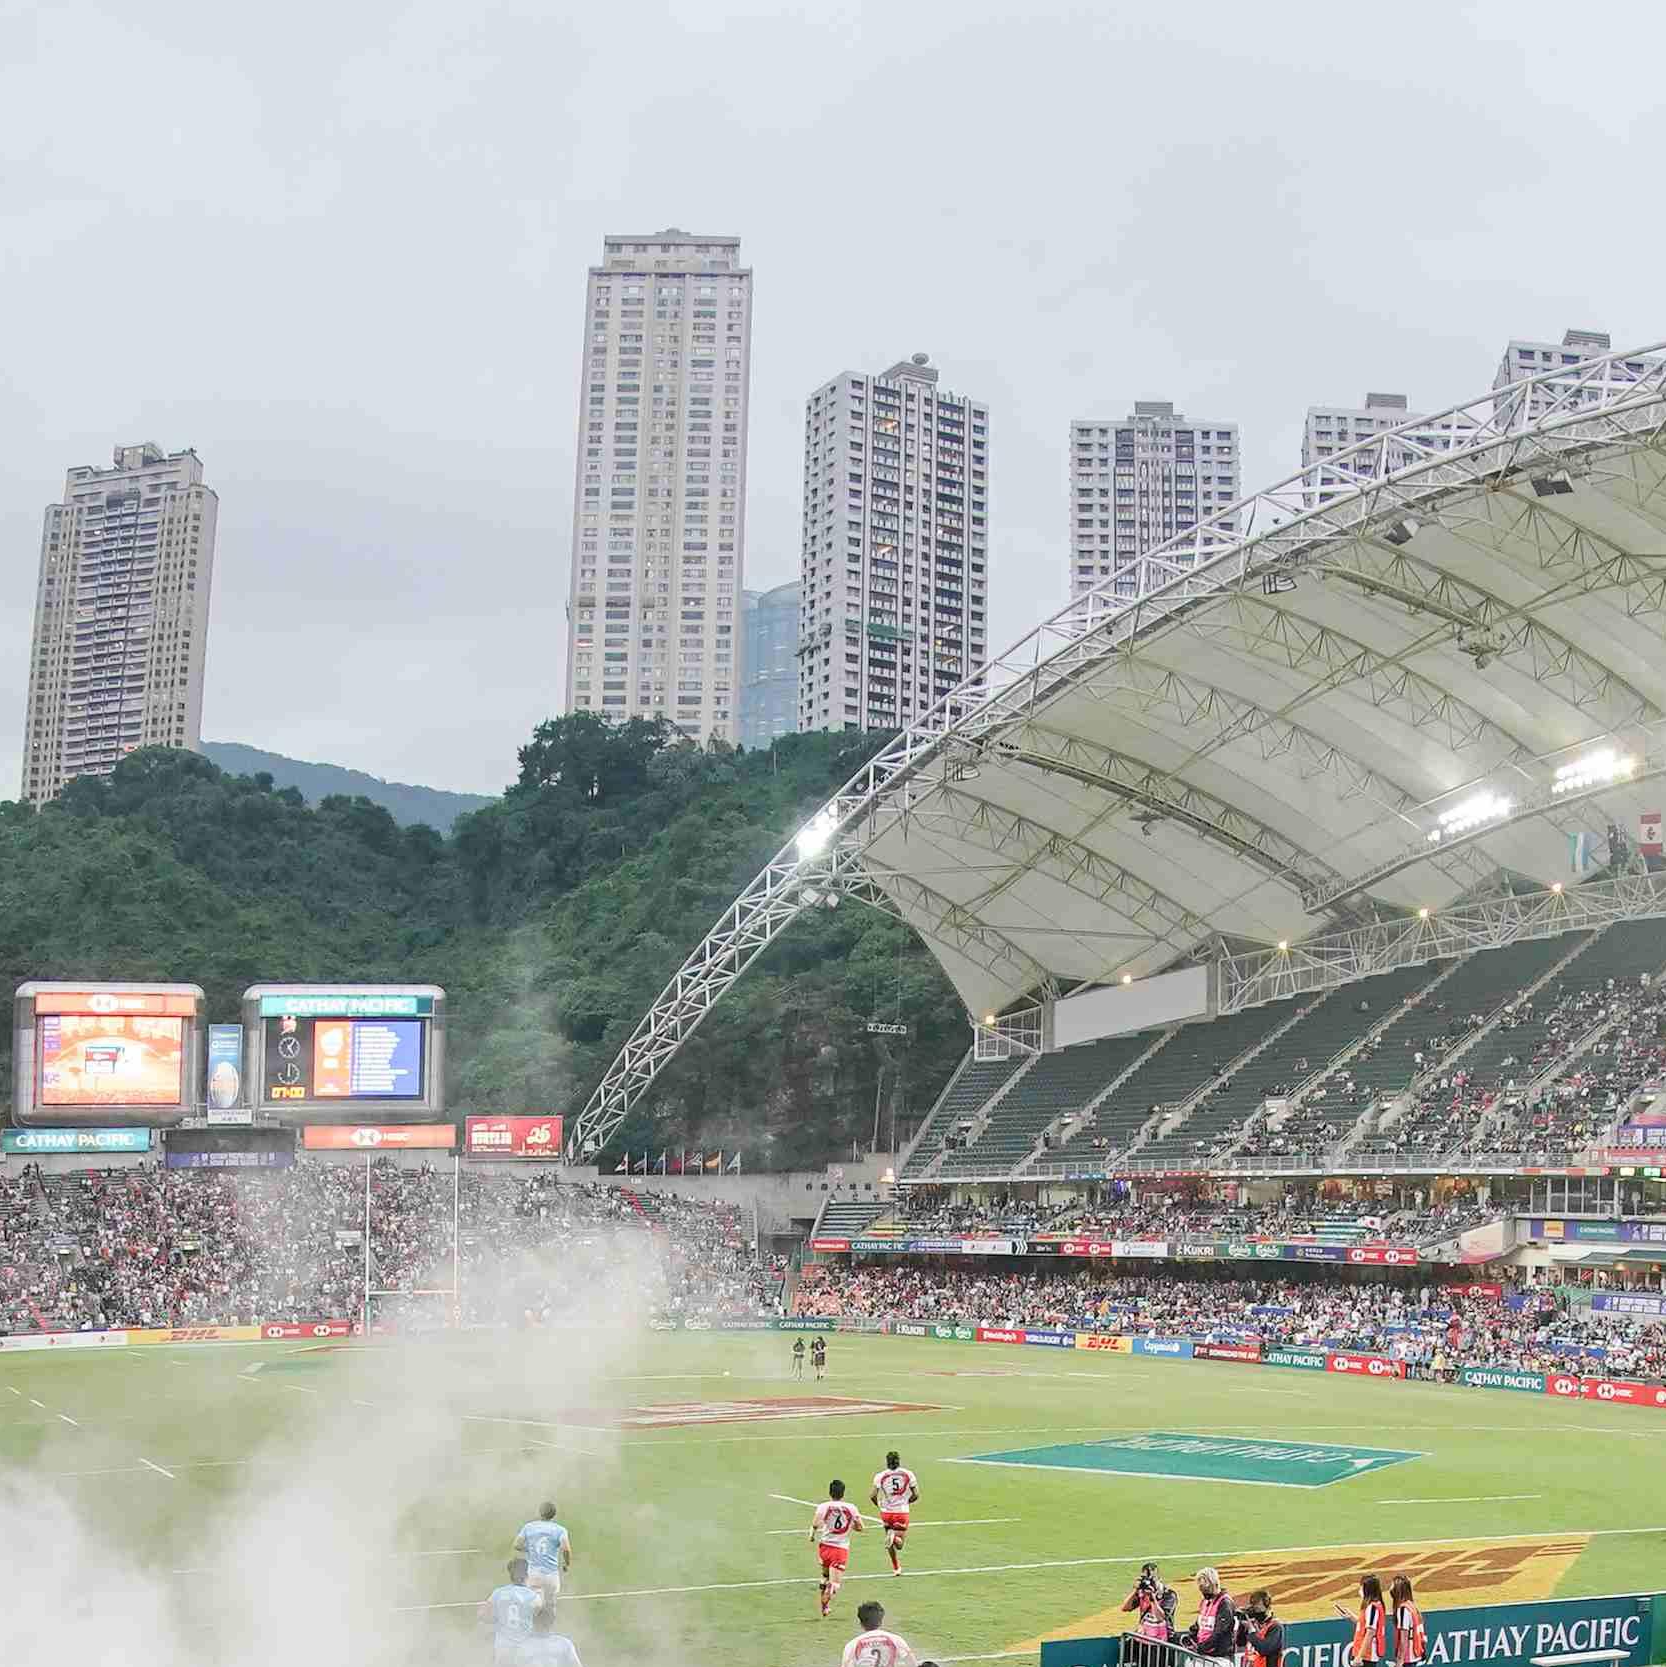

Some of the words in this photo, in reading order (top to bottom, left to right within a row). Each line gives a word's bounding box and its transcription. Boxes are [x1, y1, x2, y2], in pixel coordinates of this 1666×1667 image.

[16, 1133, 77, 1147] CATHAY
[78, 1133, 134, 1147] PACIFIC
[1183, 1244, 1214, 1256] KUKRI
[779, 1320, 805, 1329] CATHAY
[806, 1320, 830, 1329] PACIFIC
[171, 1329, 220, 1341] DHL
[1087, 1336, 1120, 1350] DHL
[1293, 1354, 1323, 1367] PACIFIC
[1465, 1371, 1504, 1385] CATHAY
[1505, 1376, 1542, 1389] PACIFIC
[892, 1478, 899, 1490] 5
[834, 1515, 841, 1529] 6
[1417, 1625, 1532, 1667] ATHAY
[1535, 1615, 1641, 1655] PACIFIC
